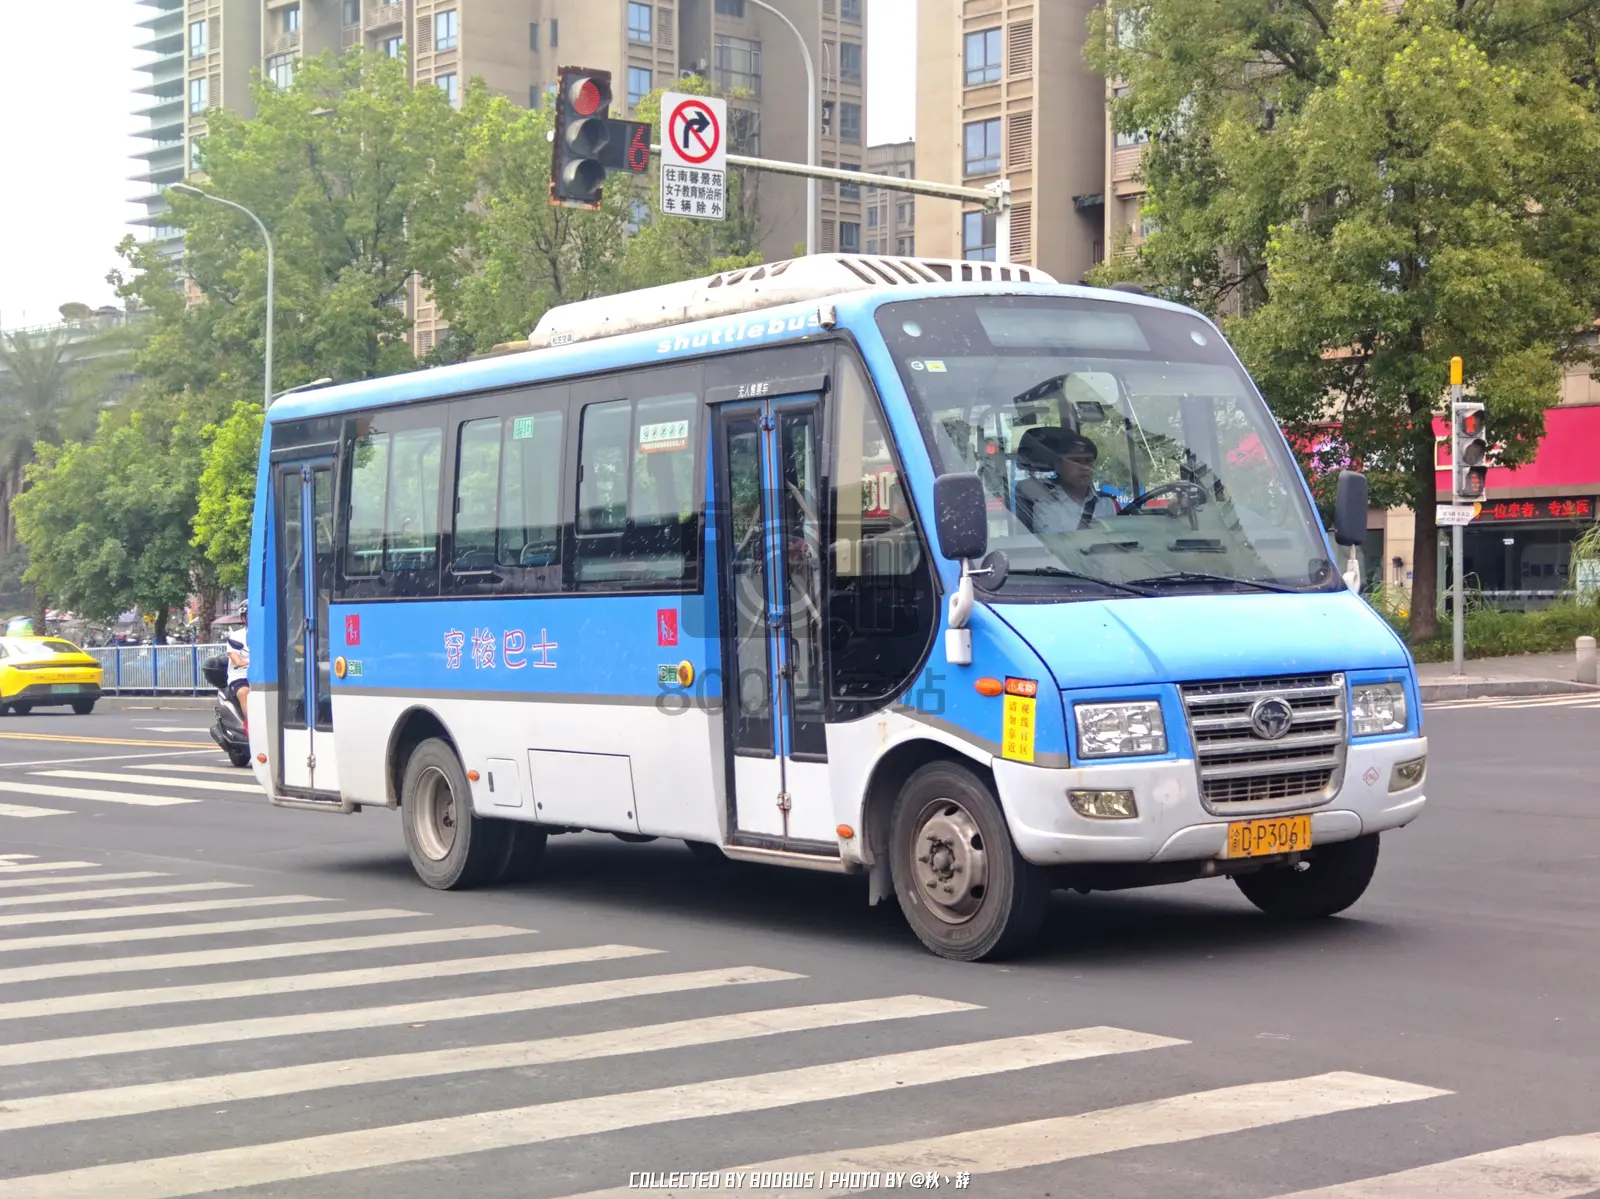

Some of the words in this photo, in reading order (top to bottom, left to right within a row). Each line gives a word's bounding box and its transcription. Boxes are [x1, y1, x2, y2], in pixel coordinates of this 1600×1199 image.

[628, 126, 649, 171] 6
[666, 168, 722, 186] 往南馨景苑
[665, 183, 722, 202] 女子教育矫治所
[665, 197, 722, 216] 车辆除外
[737, 382, 769, 399] 无人售票车
[443, 627, 559, 670] 穿梭巴士
